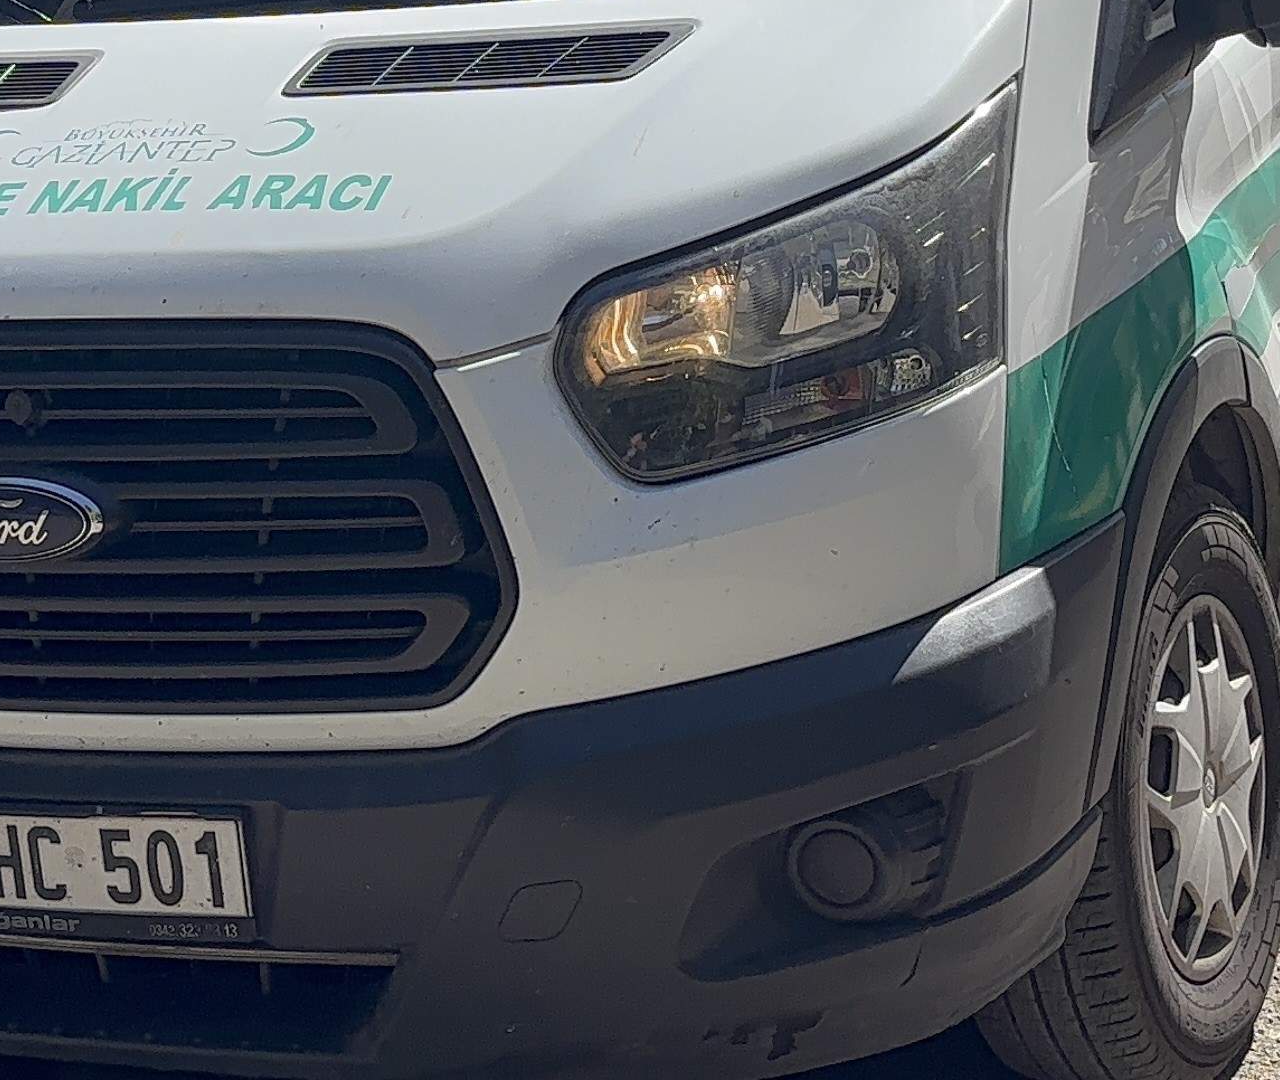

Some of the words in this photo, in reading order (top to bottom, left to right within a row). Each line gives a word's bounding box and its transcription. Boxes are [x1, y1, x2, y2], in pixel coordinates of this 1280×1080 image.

[11, 139, 237, 169] GAZİANTEP
[26, 167, 192, 212] NAKİL
[206, 174, 393, 211] ARACI
[99, 828, 225, 909] 501
